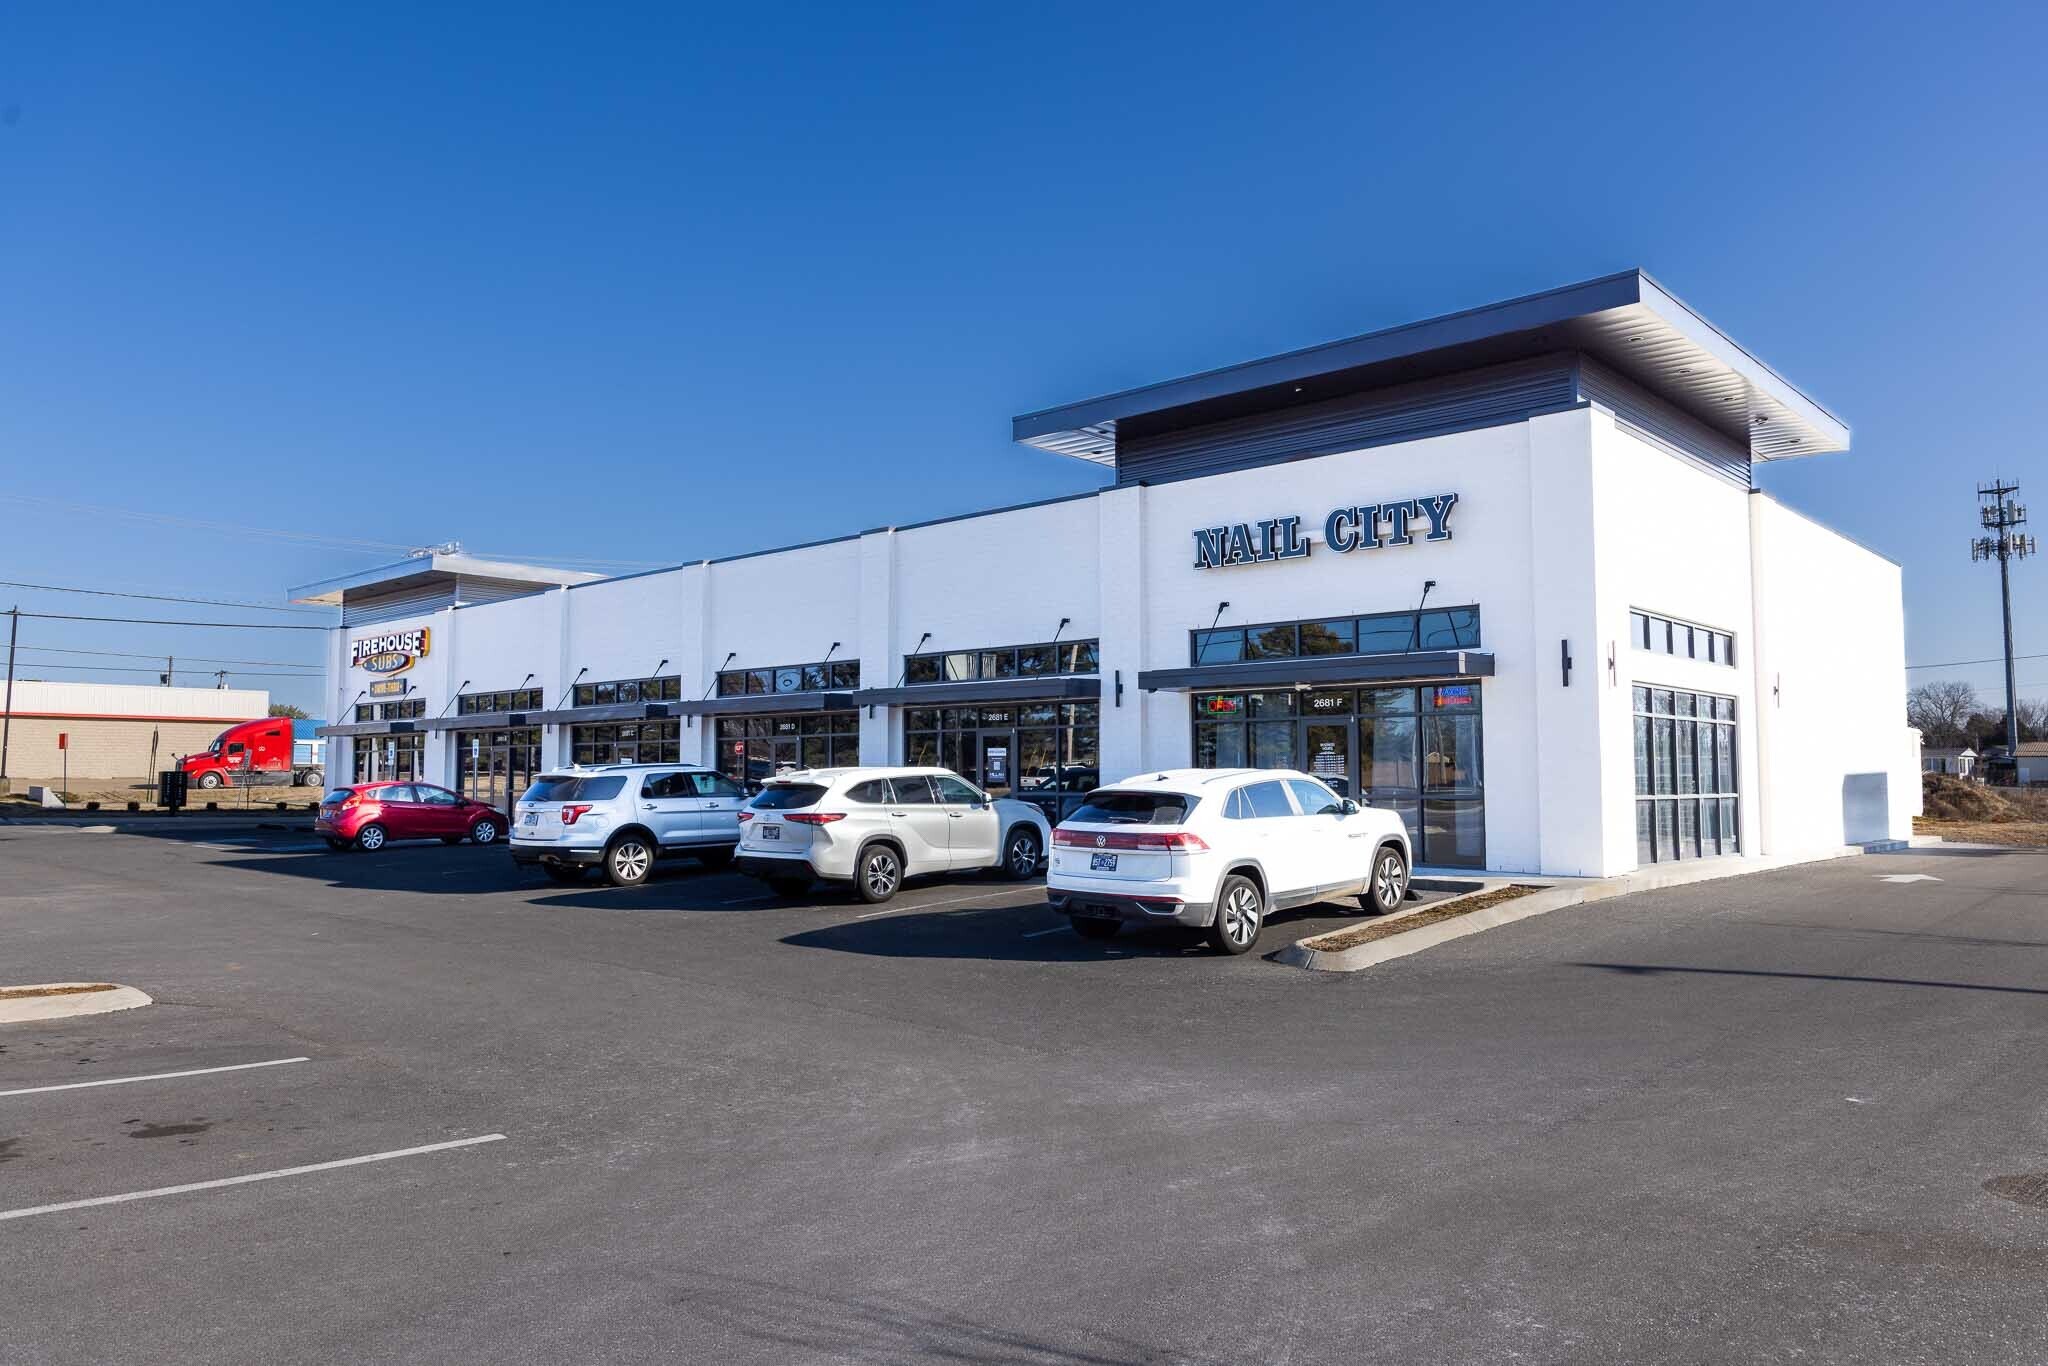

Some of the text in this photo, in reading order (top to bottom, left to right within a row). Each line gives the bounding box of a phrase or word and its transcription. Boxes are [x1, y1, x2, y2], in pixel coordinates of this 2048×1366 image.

[1193, 492, 1459, 570] NAIL CITY
[351, 630, 423, 667] FIREHOUSE
[371, 653, 398, 671] SUBS
[1314, 698, 1343, 708] 2681 F
[988, 713, 1003, 721] 2681
